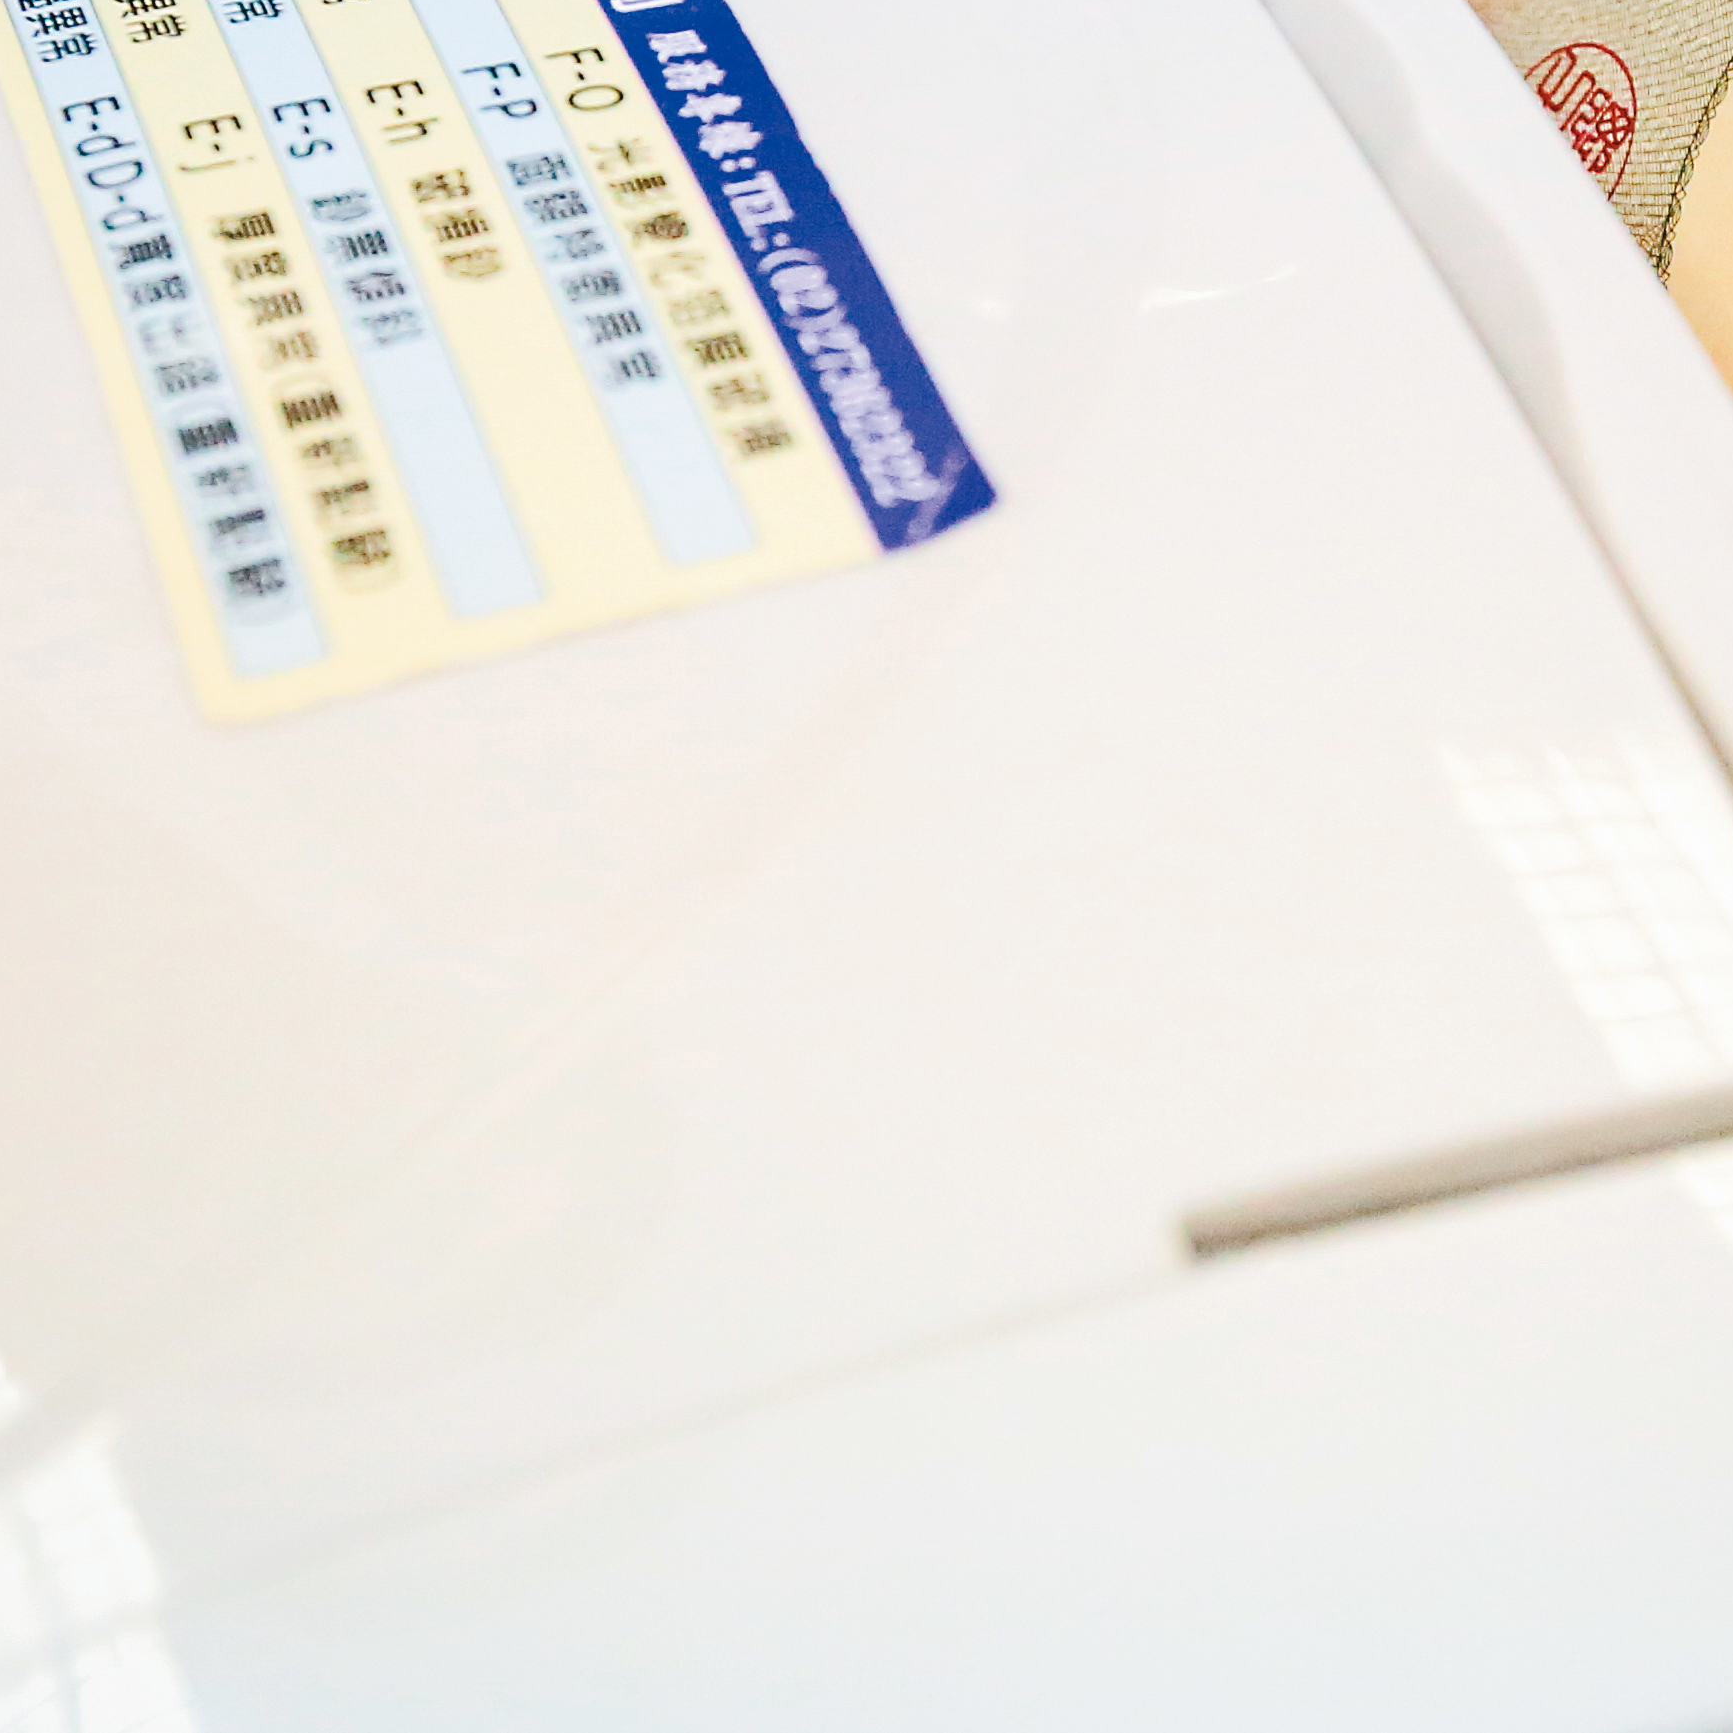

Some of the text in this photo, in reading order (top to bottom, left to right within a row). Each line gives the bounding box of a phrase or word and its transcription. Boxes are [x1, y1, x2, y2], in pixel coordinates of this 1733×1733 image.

[365, 79, 436, 142] E-h
[463, 61, 538, 118] F-P
[62, 96, 135, 156] E-d
[179, 113, 248, 173] E-j
[271, 97, 333, 158] E-s
